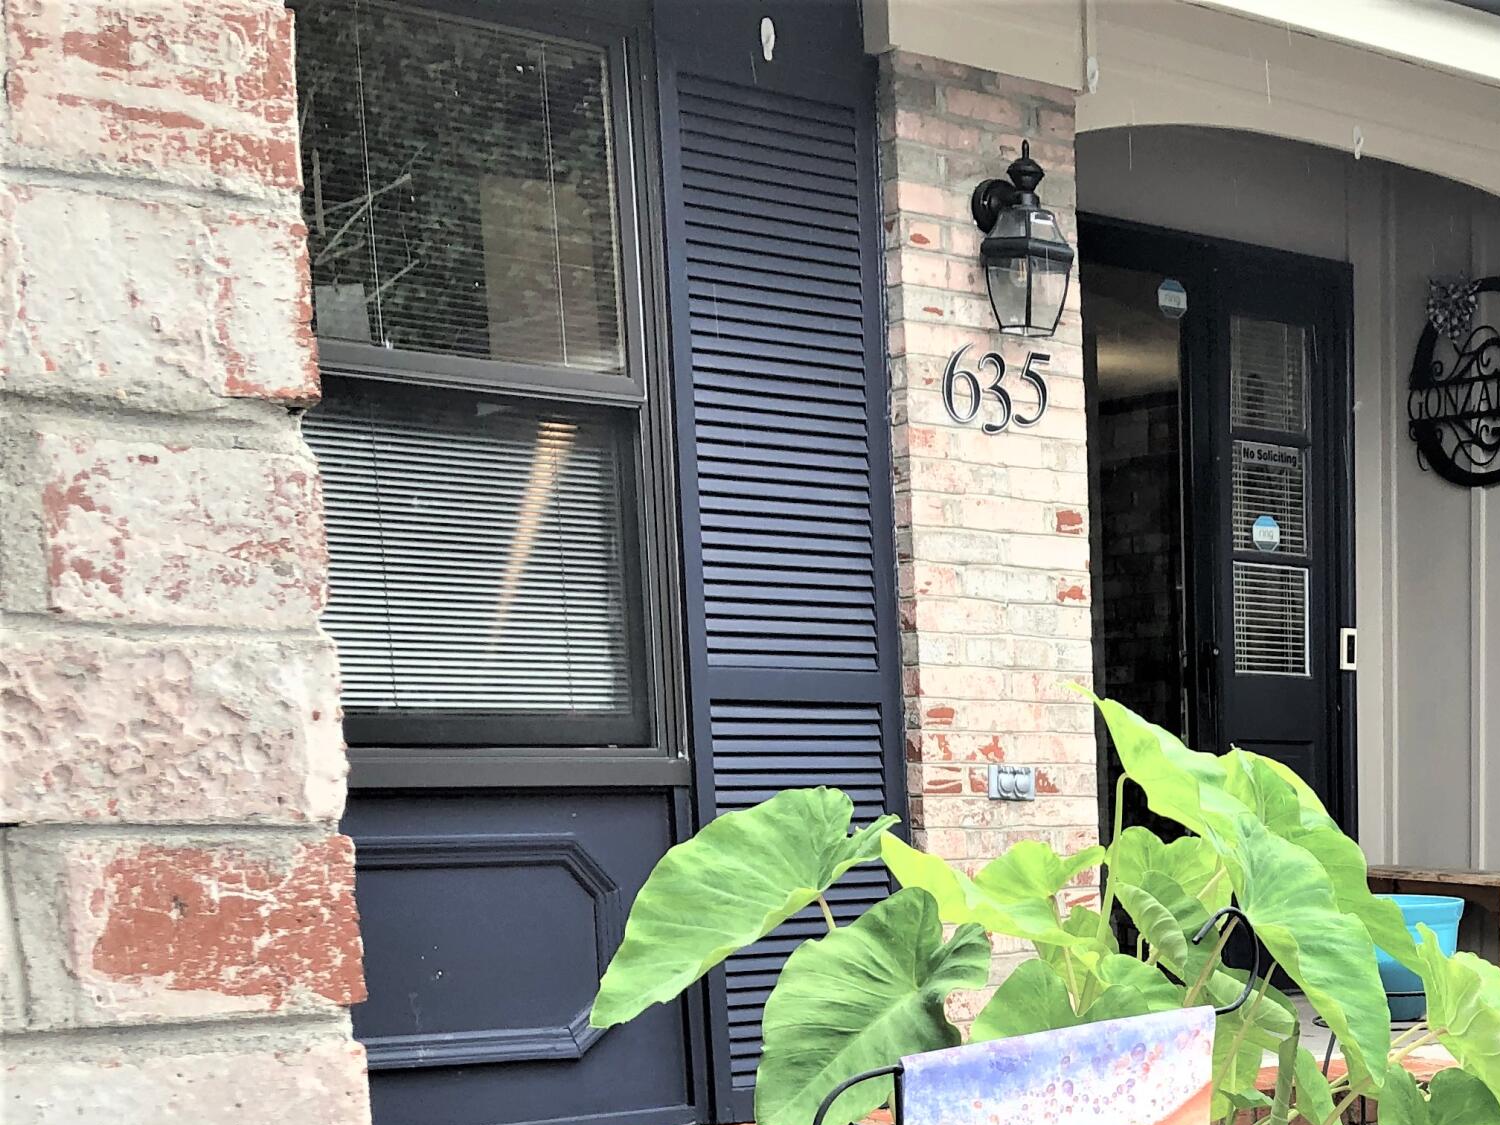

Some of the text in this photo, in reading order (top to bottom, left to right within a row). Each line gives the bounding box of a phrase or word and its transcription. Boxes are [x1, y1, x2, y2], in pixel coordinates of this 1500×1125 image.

[942, 342, 1051, 435] 635
[1243, 447, 1297, 467] No Soliciting
[1259, 529, 1274, 540] ring
